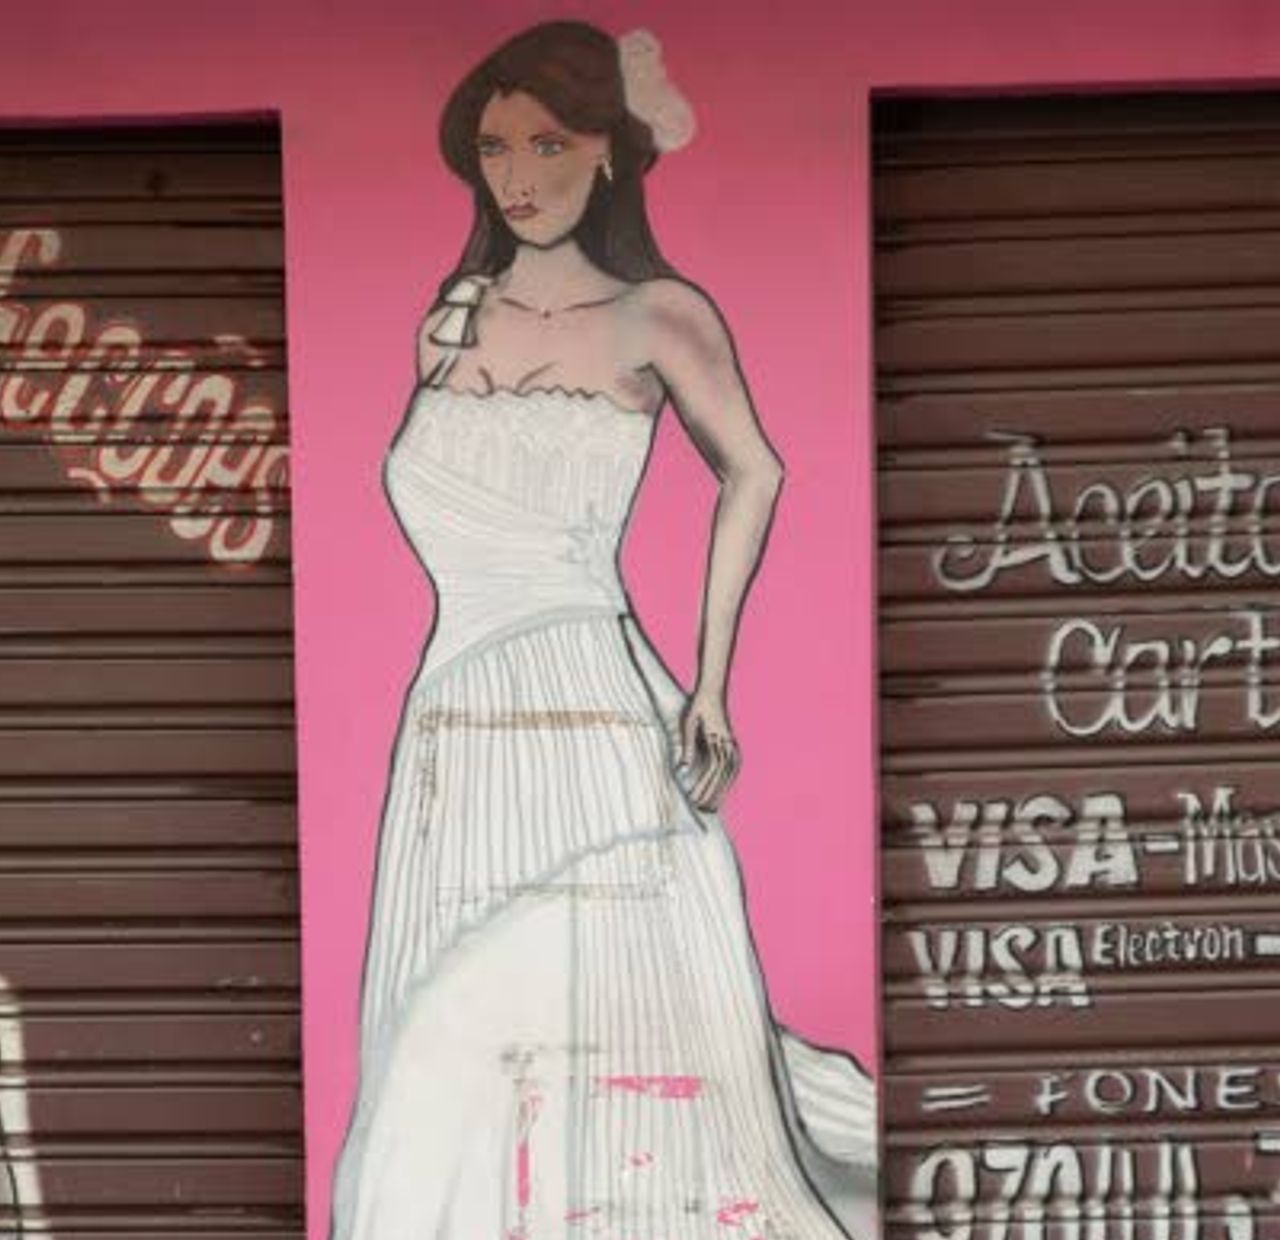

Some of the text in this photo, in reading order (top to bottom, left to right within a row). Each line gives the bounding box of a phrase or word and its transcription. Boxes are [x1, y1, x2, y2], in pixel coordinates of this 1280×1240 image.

[912, 793, 1139, 892] VISA
[908, 924, 1091, 1009] VISA
[1092, 922, 1245, 967] Electron
